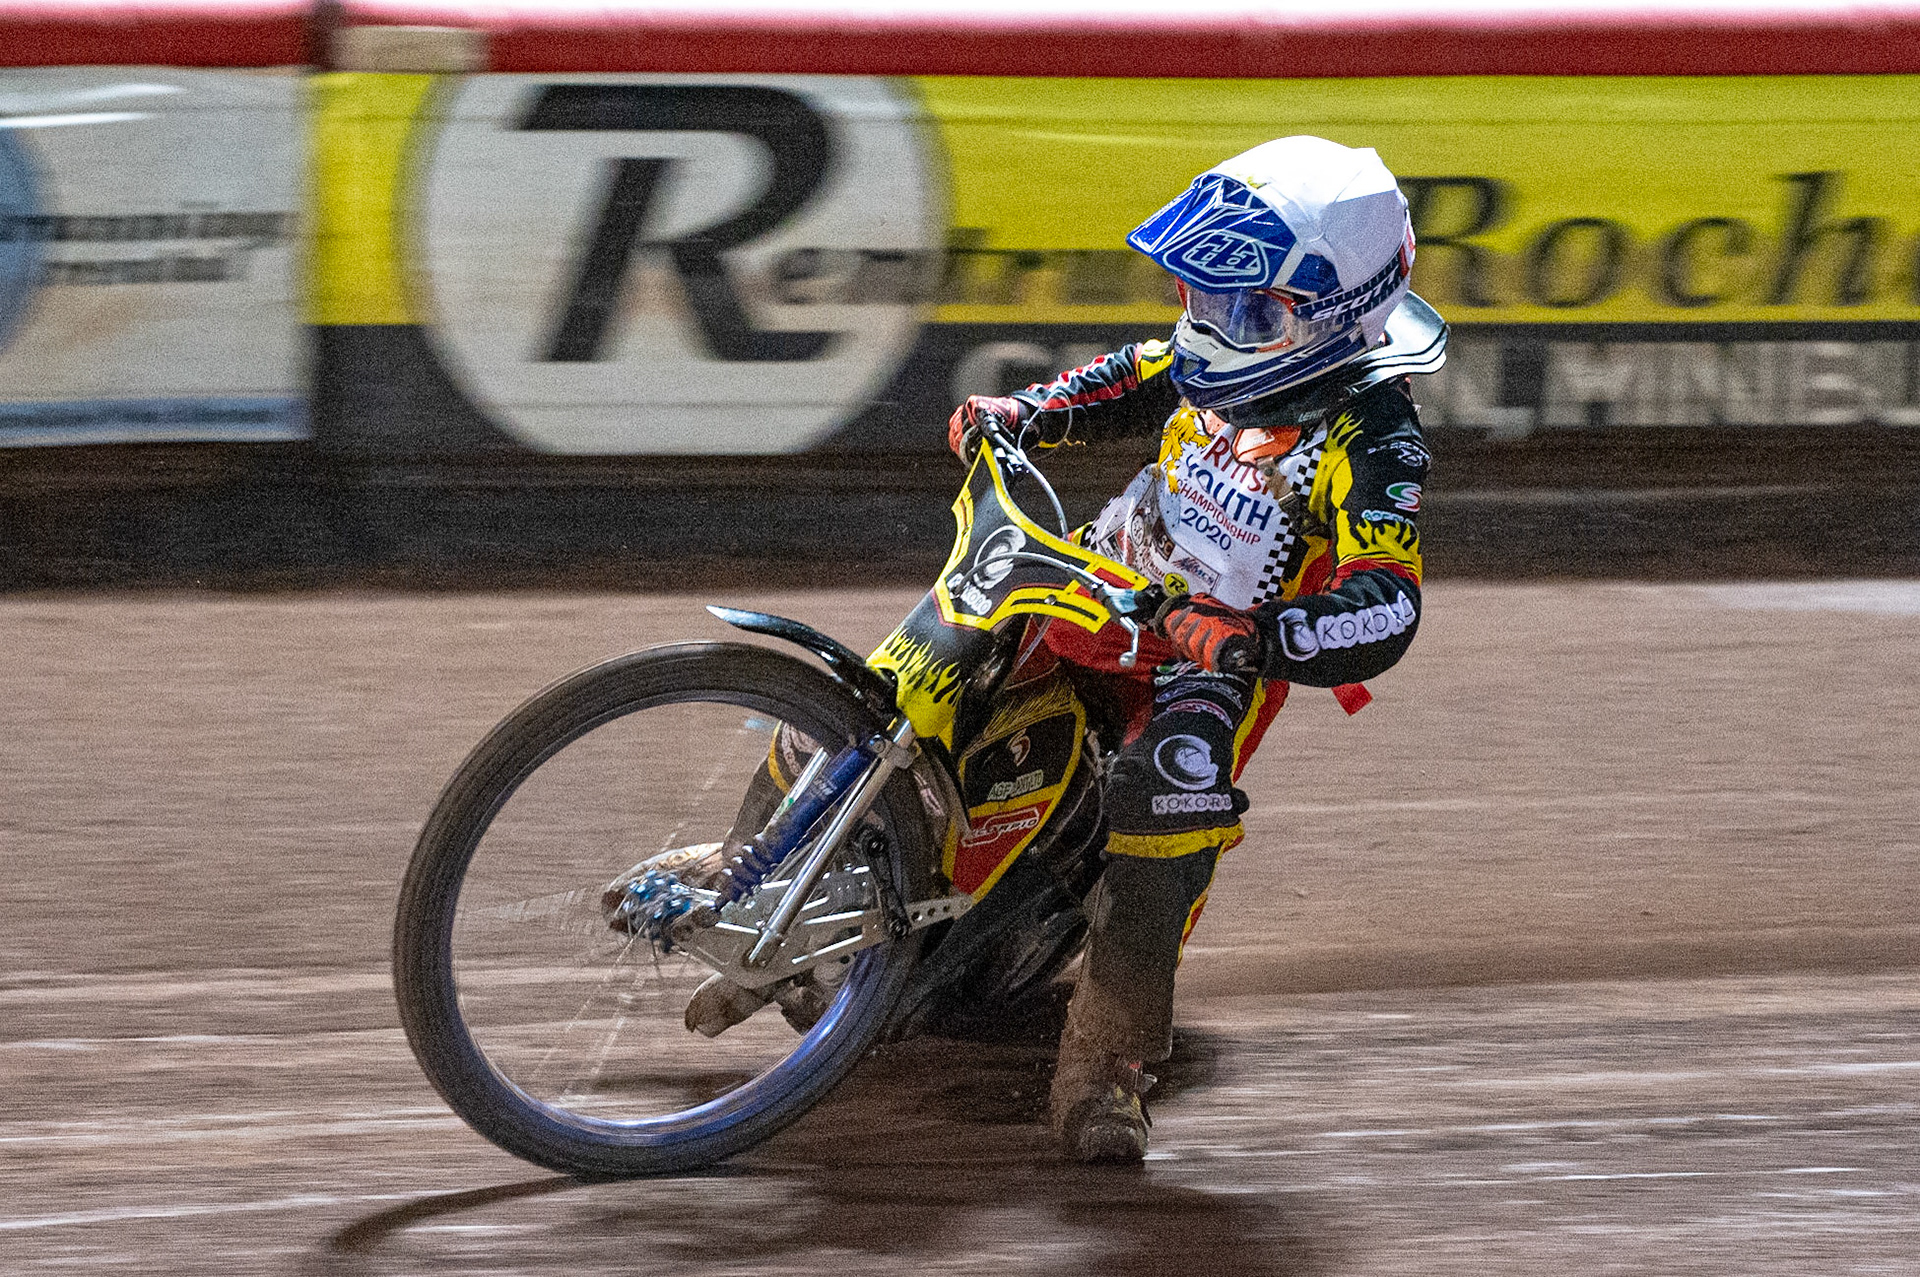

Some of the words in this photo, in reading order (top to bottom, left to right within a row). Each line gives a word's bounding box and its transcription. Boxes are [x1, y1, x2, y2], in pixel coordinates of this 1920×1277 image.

[1394, 170, 1920, 308] Roch
[1181, 506, 1232, 551] 2020
[1186, 453, 1275, 531] YOUTH
